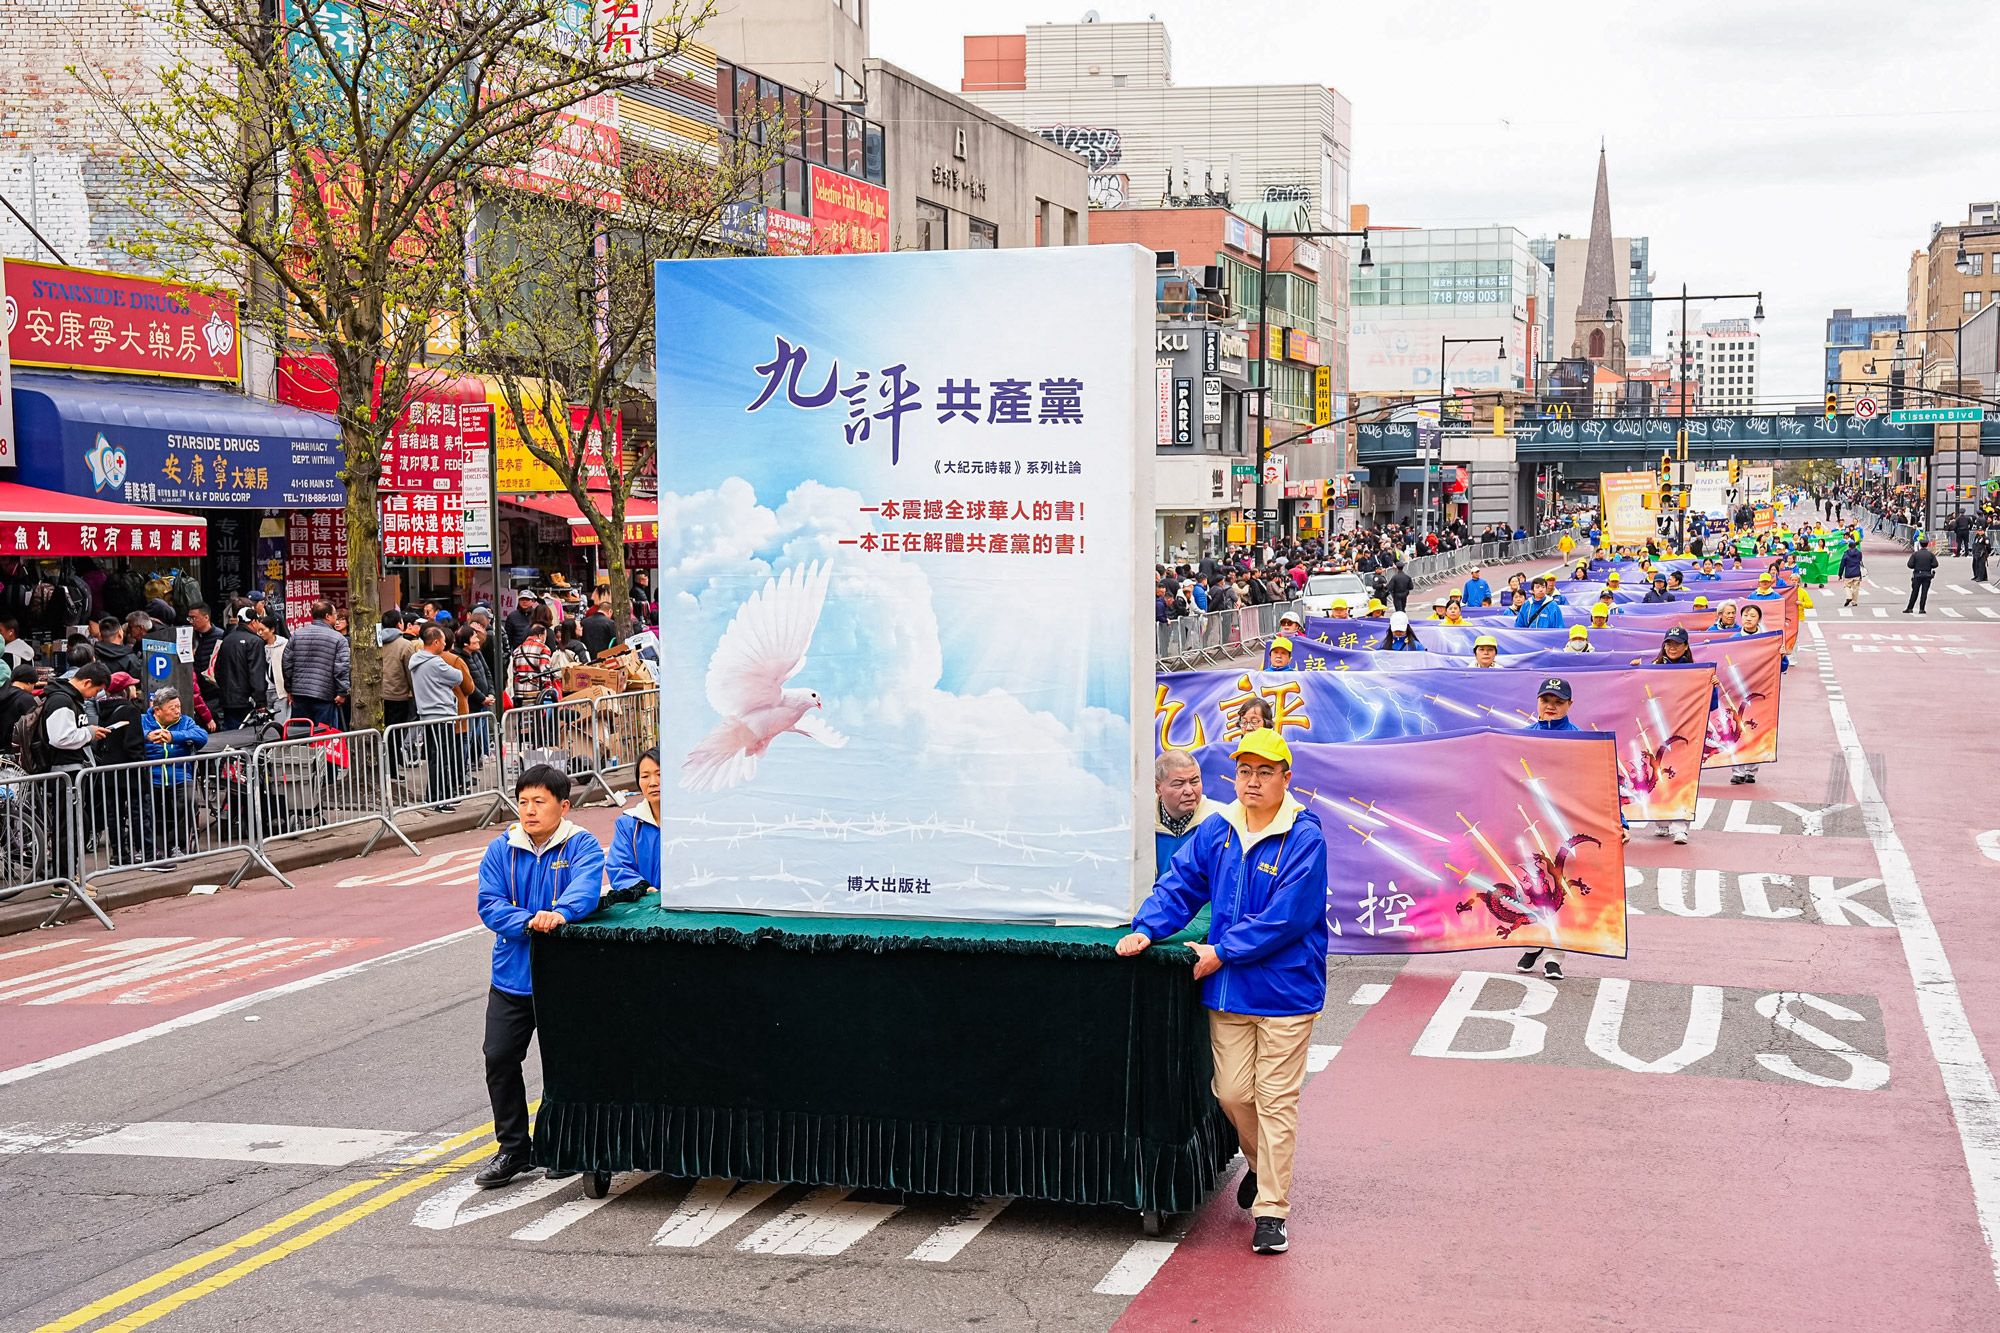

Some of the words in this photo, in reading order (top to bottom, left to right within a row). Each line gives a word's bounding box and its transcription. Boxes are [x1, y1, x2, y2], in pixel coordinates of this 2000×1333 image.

[815, 176, 842, 206] Selective
[842, 184, 855, 210] First
[856, 190, 875, 219] Realty,
[876, 196, 886, 220] Inc.
[32, 280, 126, 308] STARSIDE
[130, 290, 190, 316] DRUGS
[1434, 291, 1452, 303] 718
[1456, 291, 1475, 302] 799
[1478, 290, 1504, 302] 0031
[24, 306, 201, 362] 安康寧大藥房
[1156, 330, 1189, 352] ku
[746, 334, 922, 466] 九評
[936, 377, 1084, 426] 共產黨
[1178, 388, 1189, 431] PARK
[1900, 412, 1945, 421] Kissena
[1948, 411, 1974, 419] Blvd
[167, 434, 221, 451] STARSIDE
[224, 438, 260, 452] DRUGS
[291, 441, 328, 452] PHARMACY
[399, 433, 439, 450] 信箱出租
[292, 455, 310, 464] DEPT.
[311, 456, 335, 465] WITHIN
[465, 451, 471, 462] 2
[162, 452, 269, 490] 安康寧大藥房
[932, 460, 1082, 476] 《大紀元時報》系列社論
[124, 481, 156, 502] 華隆珠寶
[291, 479, 308, 488] 41-16
[309, 479, 324, 488] MAIN
[326, 480, 334, 488] ST.
[188, 492, 195, 501] K
[196, 492, 201, 501] &
[202, 493, 207, 501] F
[209, 492, 230, 502] DRUG
[232, 493, 250, 502] CORP
[283, 494, 298, 502] TEL:
[466, 510, 472, 521] 2
[860, 500, 1085, 522] 一本震撼全球華人的書！
[384, 514, 438, 532] 国际快递
[14, 525, 50, 551] 魚丸
[384, 535, 439, 555] 复印传真
[838, 532, 1085, 554] 一本正在解體共產黨的書！
[286, 580, 320, 598] 信箱出租
[1851, 644, 1964, 654] BUS
[156, 657, 167, 676] P
[1155, 674, 1310, 751] 九評
[847, 876, 932, 894] 博大出版社
[1410, 970, 1892, 1091] BUS
